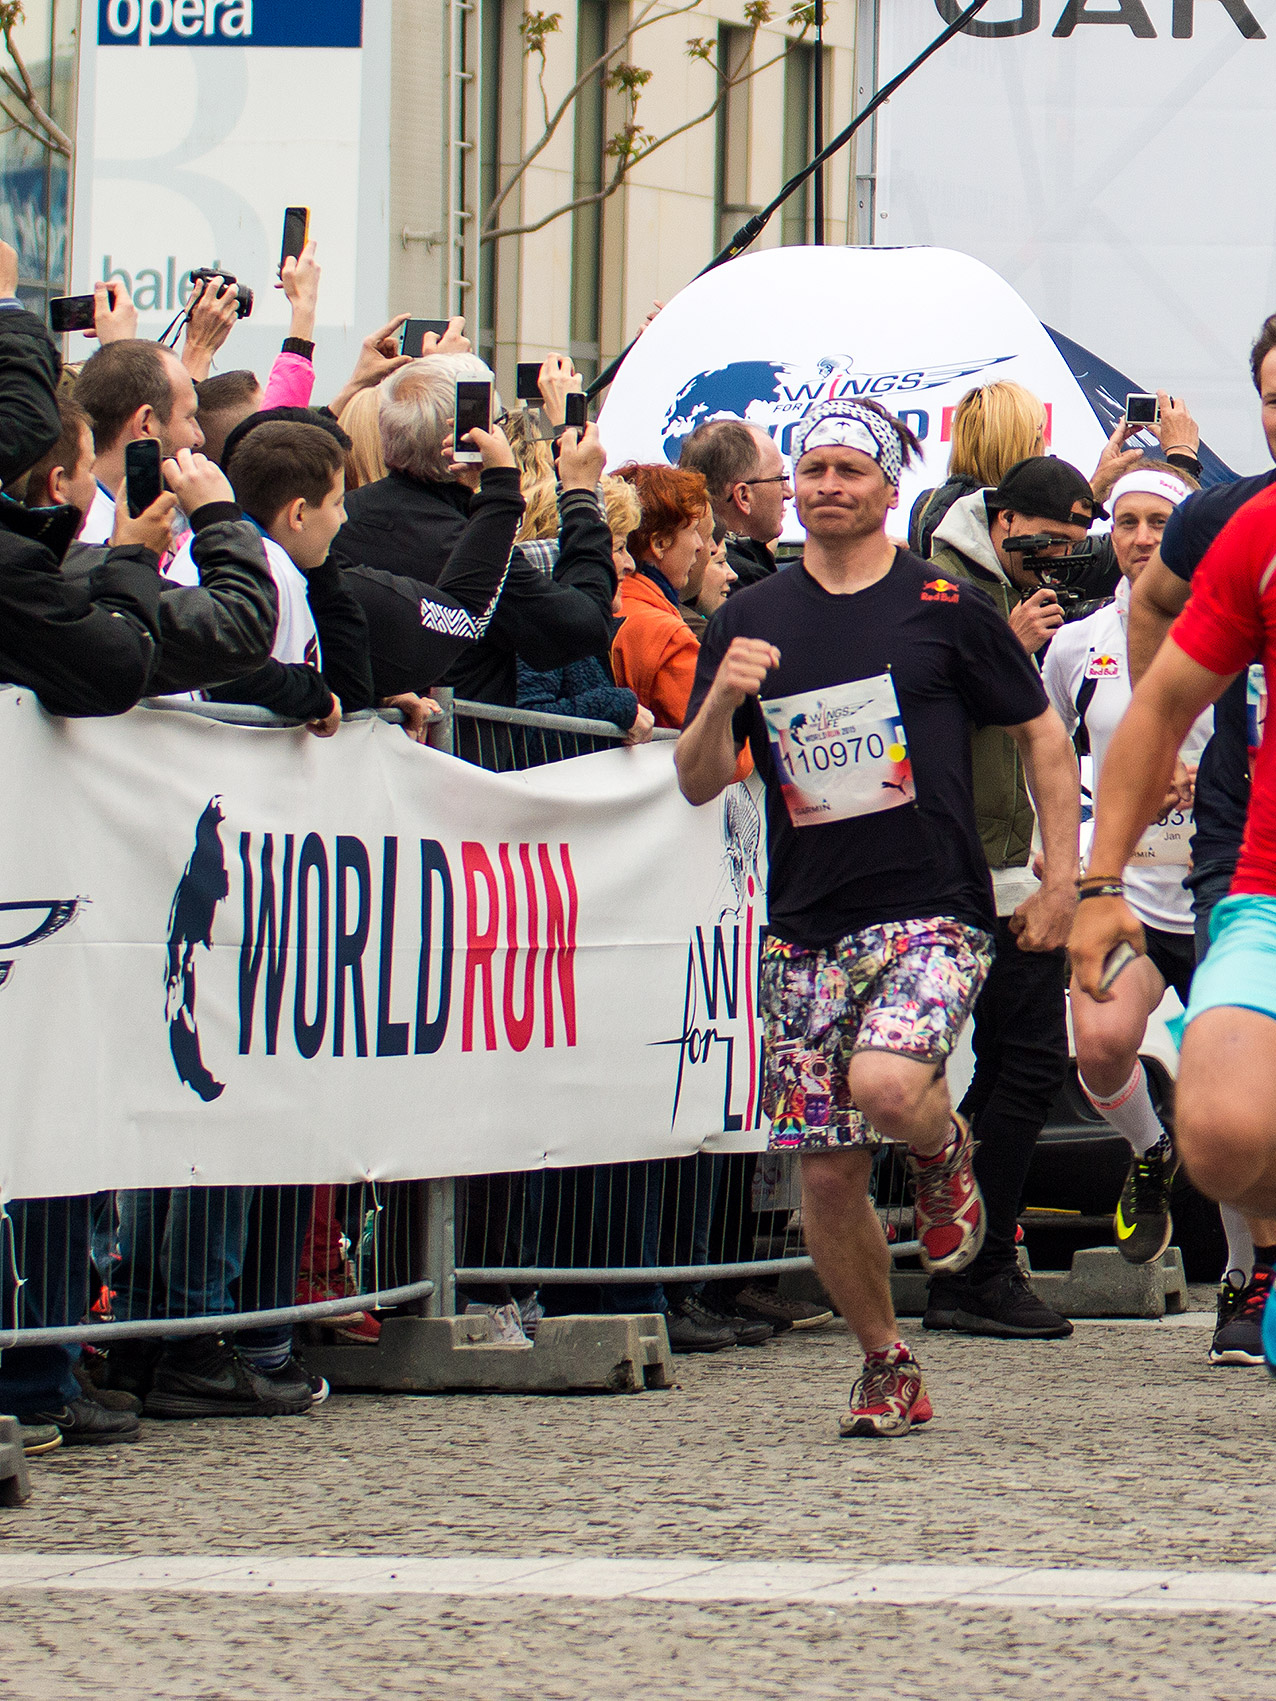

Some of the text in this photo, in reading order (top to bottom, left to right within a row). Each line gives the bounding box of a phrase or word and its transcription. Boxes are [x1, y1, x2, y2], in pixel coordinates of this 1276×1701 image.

[107, 0, 252, 46] opera
[773, 404, 803, 413] FOR
[783, 733, 885, 777] 110970
[1164, 832, 1181, 841] Jan
[238, 831, 578, 1059] WORLD RUN
